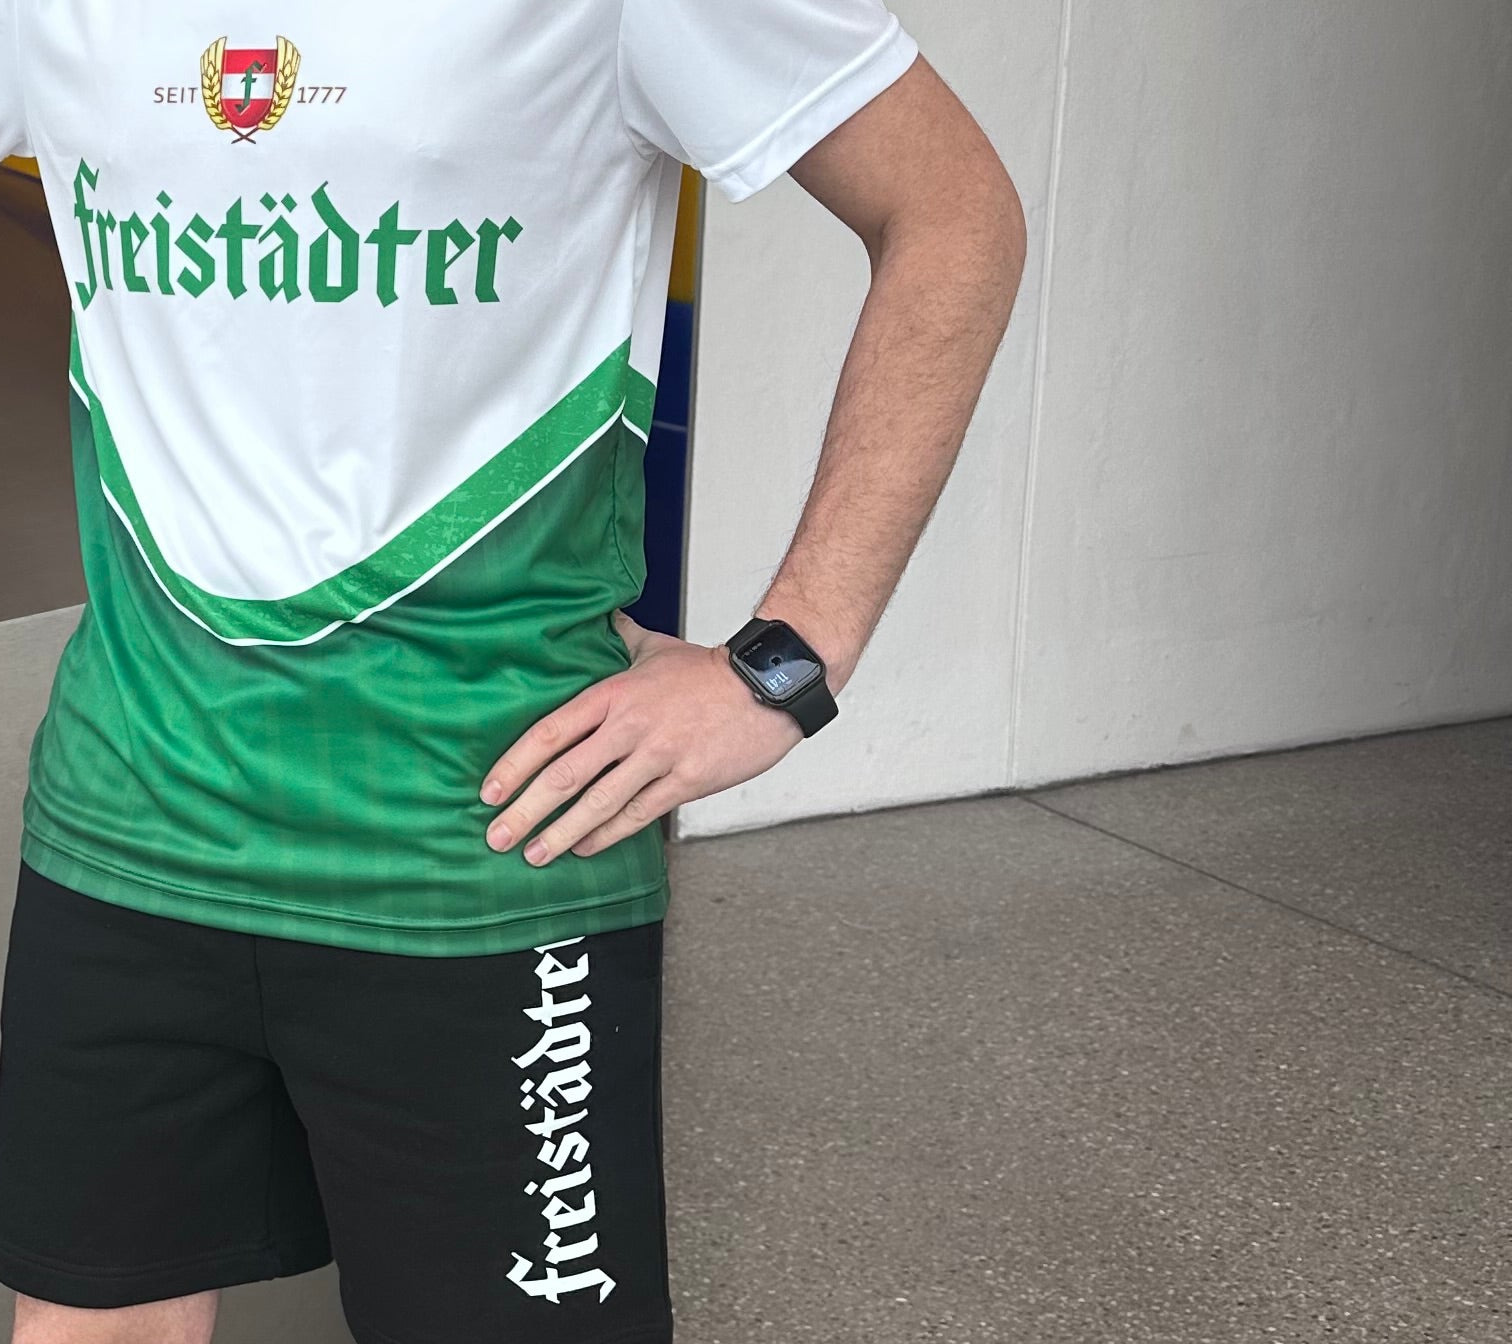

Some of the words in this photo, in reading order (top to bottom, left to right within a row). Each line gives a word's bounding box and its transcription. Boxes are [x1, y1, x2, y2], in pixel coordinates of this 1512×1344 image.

[153, 86, 198, 104] SEIT
[296, 85, 348, 105] 1777
[73, 157, 524, 312] freistädter
